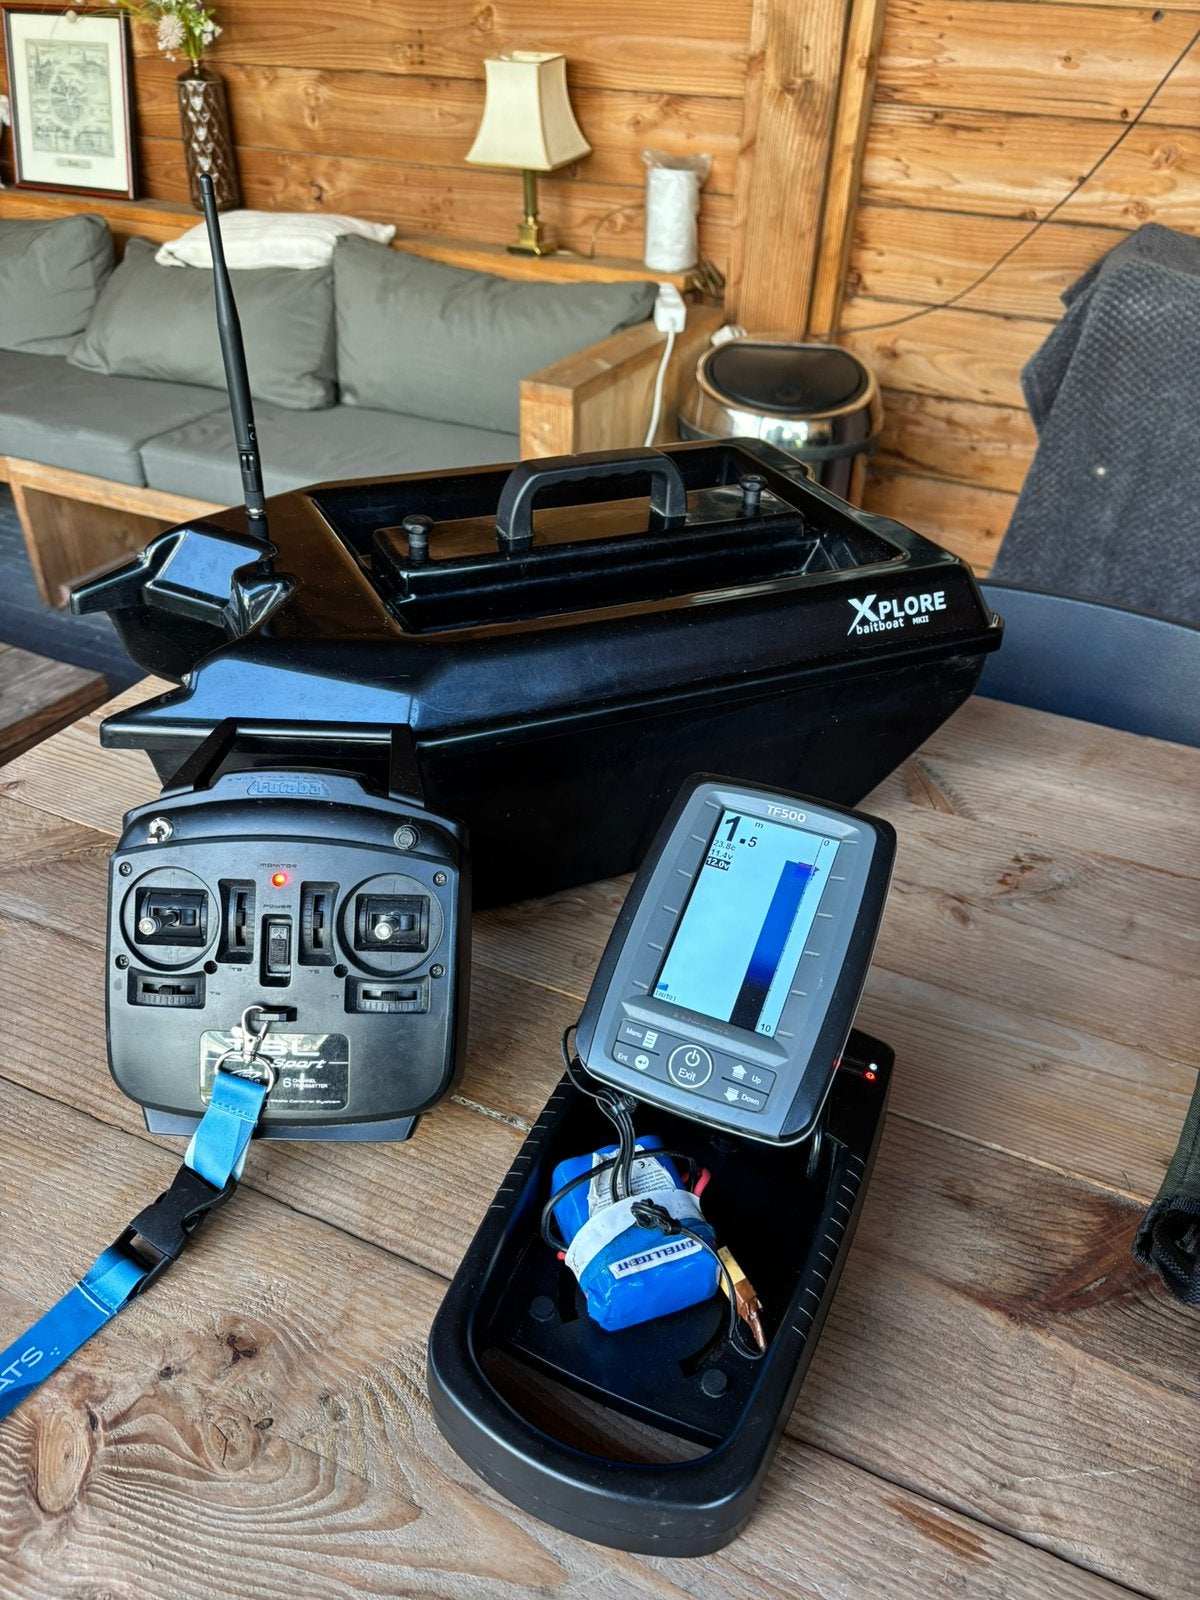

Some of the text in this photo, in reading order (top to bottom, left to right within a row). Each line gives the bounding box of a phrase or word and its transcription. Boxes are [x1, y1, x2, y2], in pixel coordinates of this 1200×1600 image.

[847, 591, 947, 636] XPLORE
[856, 615, 930, 635] baitboat MKII
[256, 781, 321, 795] Futaba
[767, 805, 807, 823] TF500
[706, 857, 730, 870] 12.0v
[626, 1027, 642, 1038] Menu
[761, 1023, 772, 1032] 10
[272, 1058, 327, 1069] Sport
[617, 1052, 628, 1062] Ent
[678, 1067, 697, 1082] Exit
[751, 1074, 762, 1085] Up
[282, 1077, 292, 1088] 6
[741, 1093, 760, 1106] Down
[618, 1240, 697, 1272] INTELLIGENT
